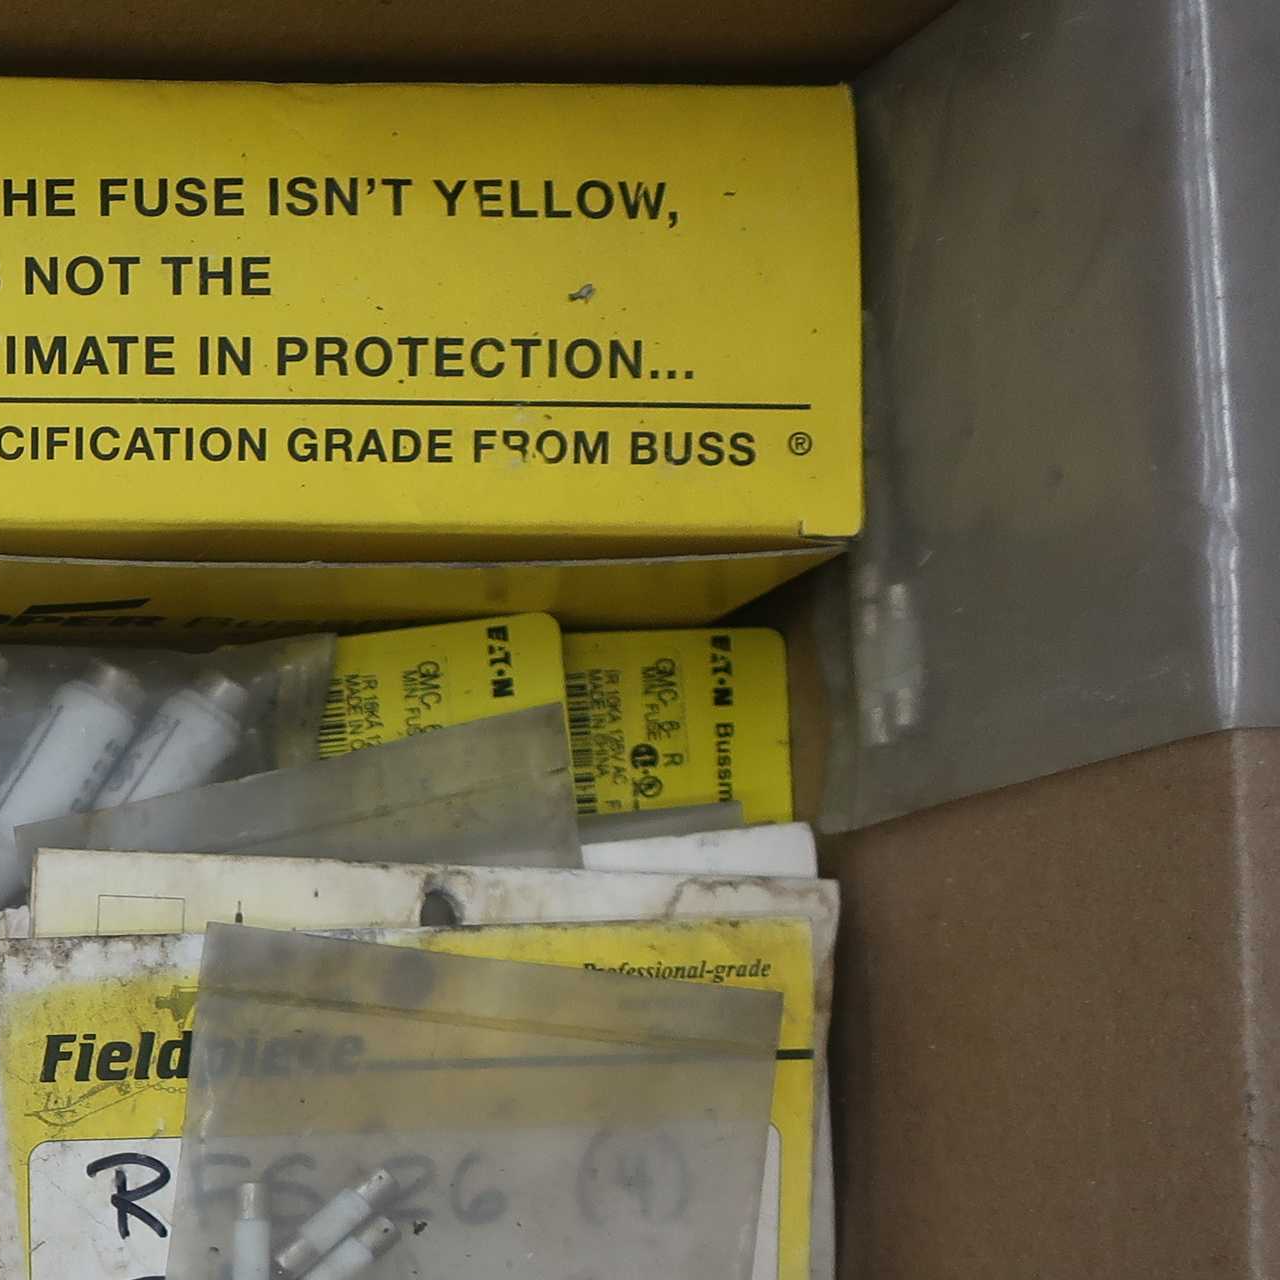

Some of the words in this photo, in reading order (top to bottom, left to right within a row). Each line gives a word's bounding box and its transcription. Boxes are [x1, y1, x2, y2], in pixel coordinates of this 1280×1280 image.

[100, 179, 245, 218] FUSE
[268, 179, 412, 218] ISN'T
[434, 179, 680, 231] YELLOW,
[23, 257, 139, 297] NOT
[162, 257, 273, 297] THE
[199, 337, 252, 376] IN
[276, 337, 694, 382] PROTECTION...
[286, 428, 453, 464] GRADE
[474, 429, 610, 466] FROM
[629, 430, 756, 467] BUSS
[715, 722, 734, 802] Bussm
[582, 961, 772, 983] Professional-grade
